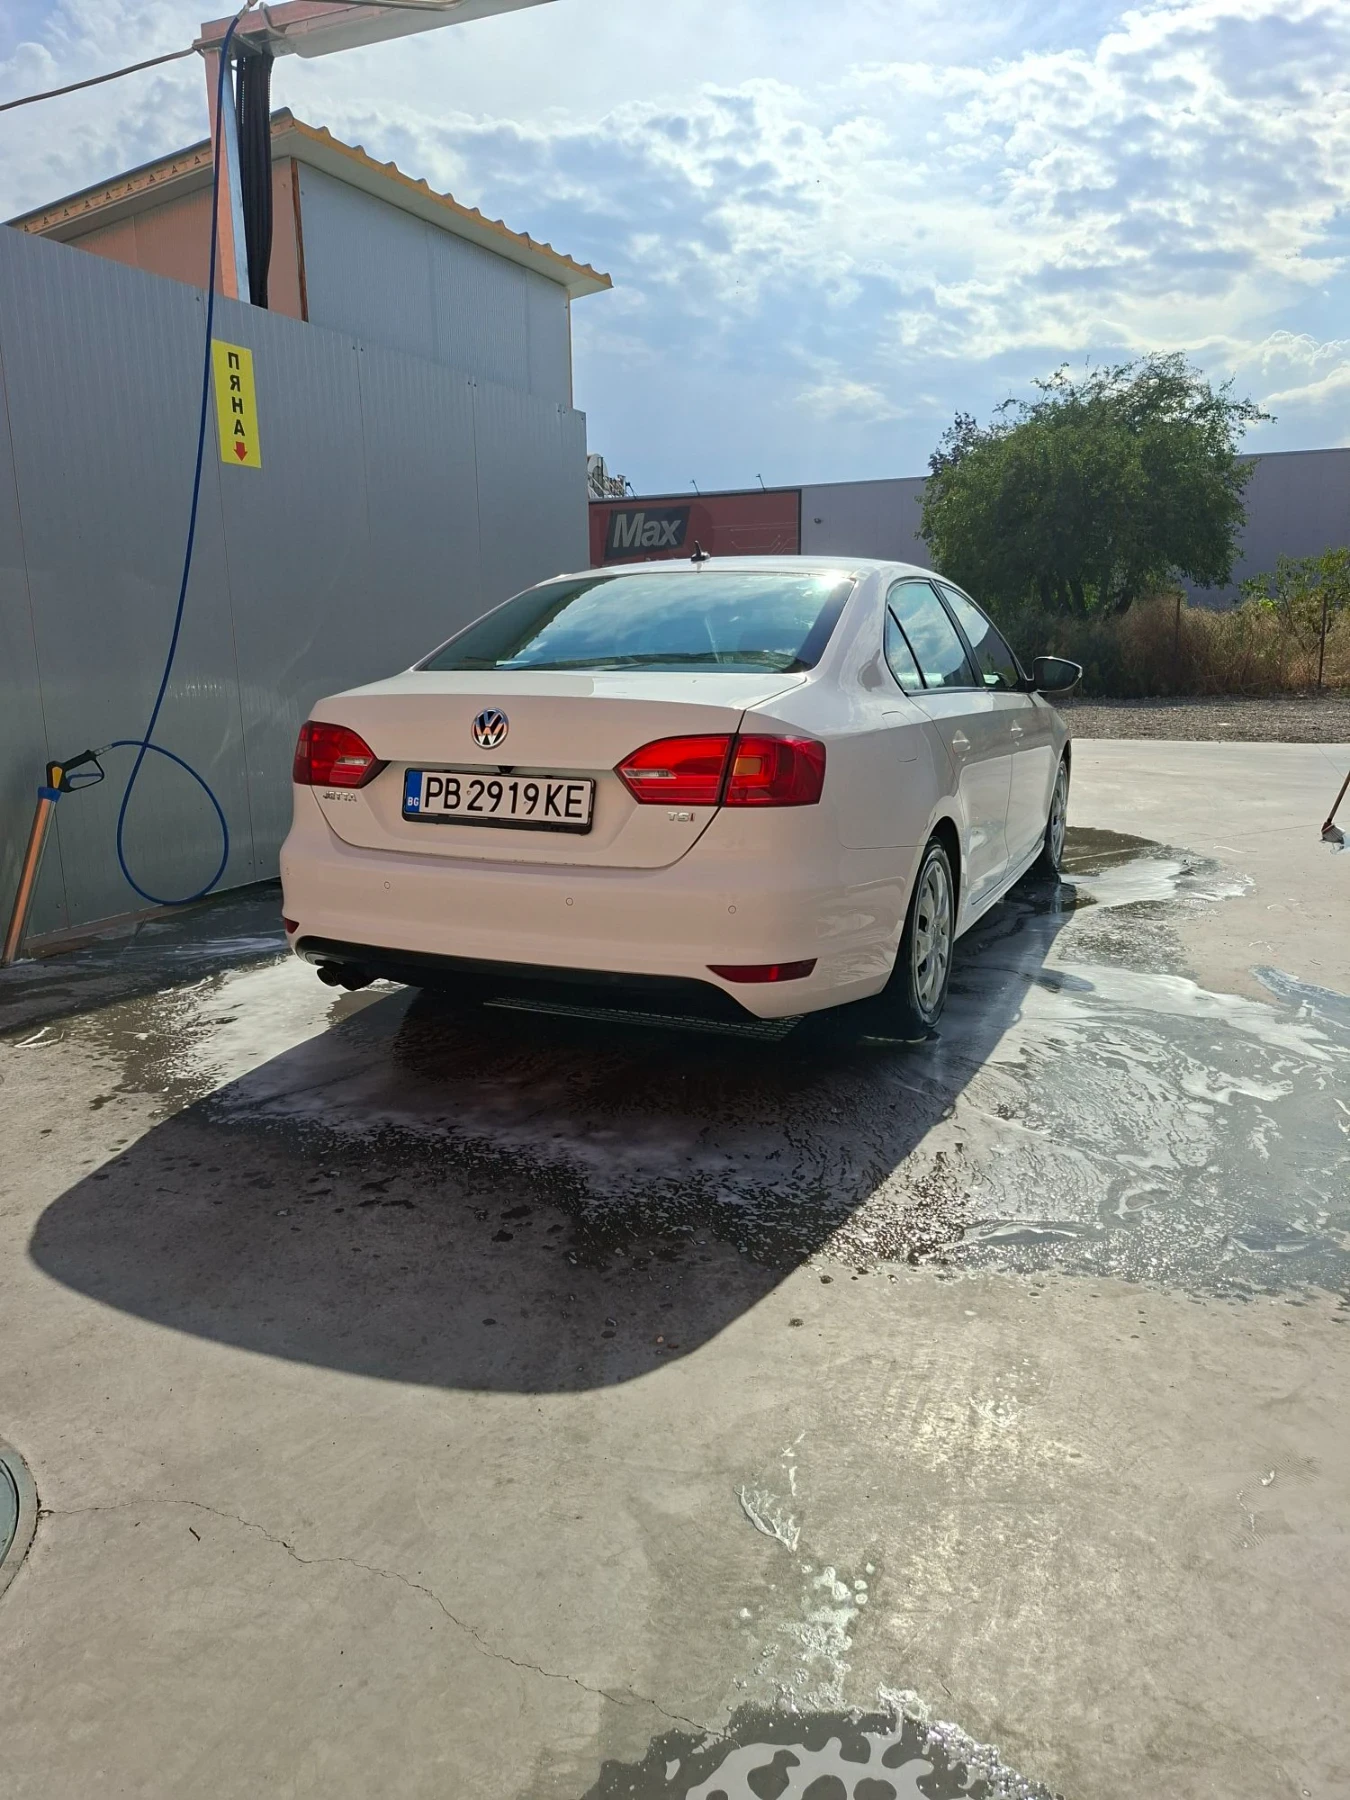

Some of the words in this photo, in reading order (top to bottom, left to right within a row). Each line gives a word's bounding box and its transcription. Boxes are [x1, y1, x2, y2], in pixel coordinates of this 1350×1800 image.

[227, 351, 246, 437] ПЯНА
[612, 512, 682, 548] Max
[407, 797, 419, 807] BG
[424, 776, 585, 819] PB2919KE
[667, 811, 695, 822] TSI
